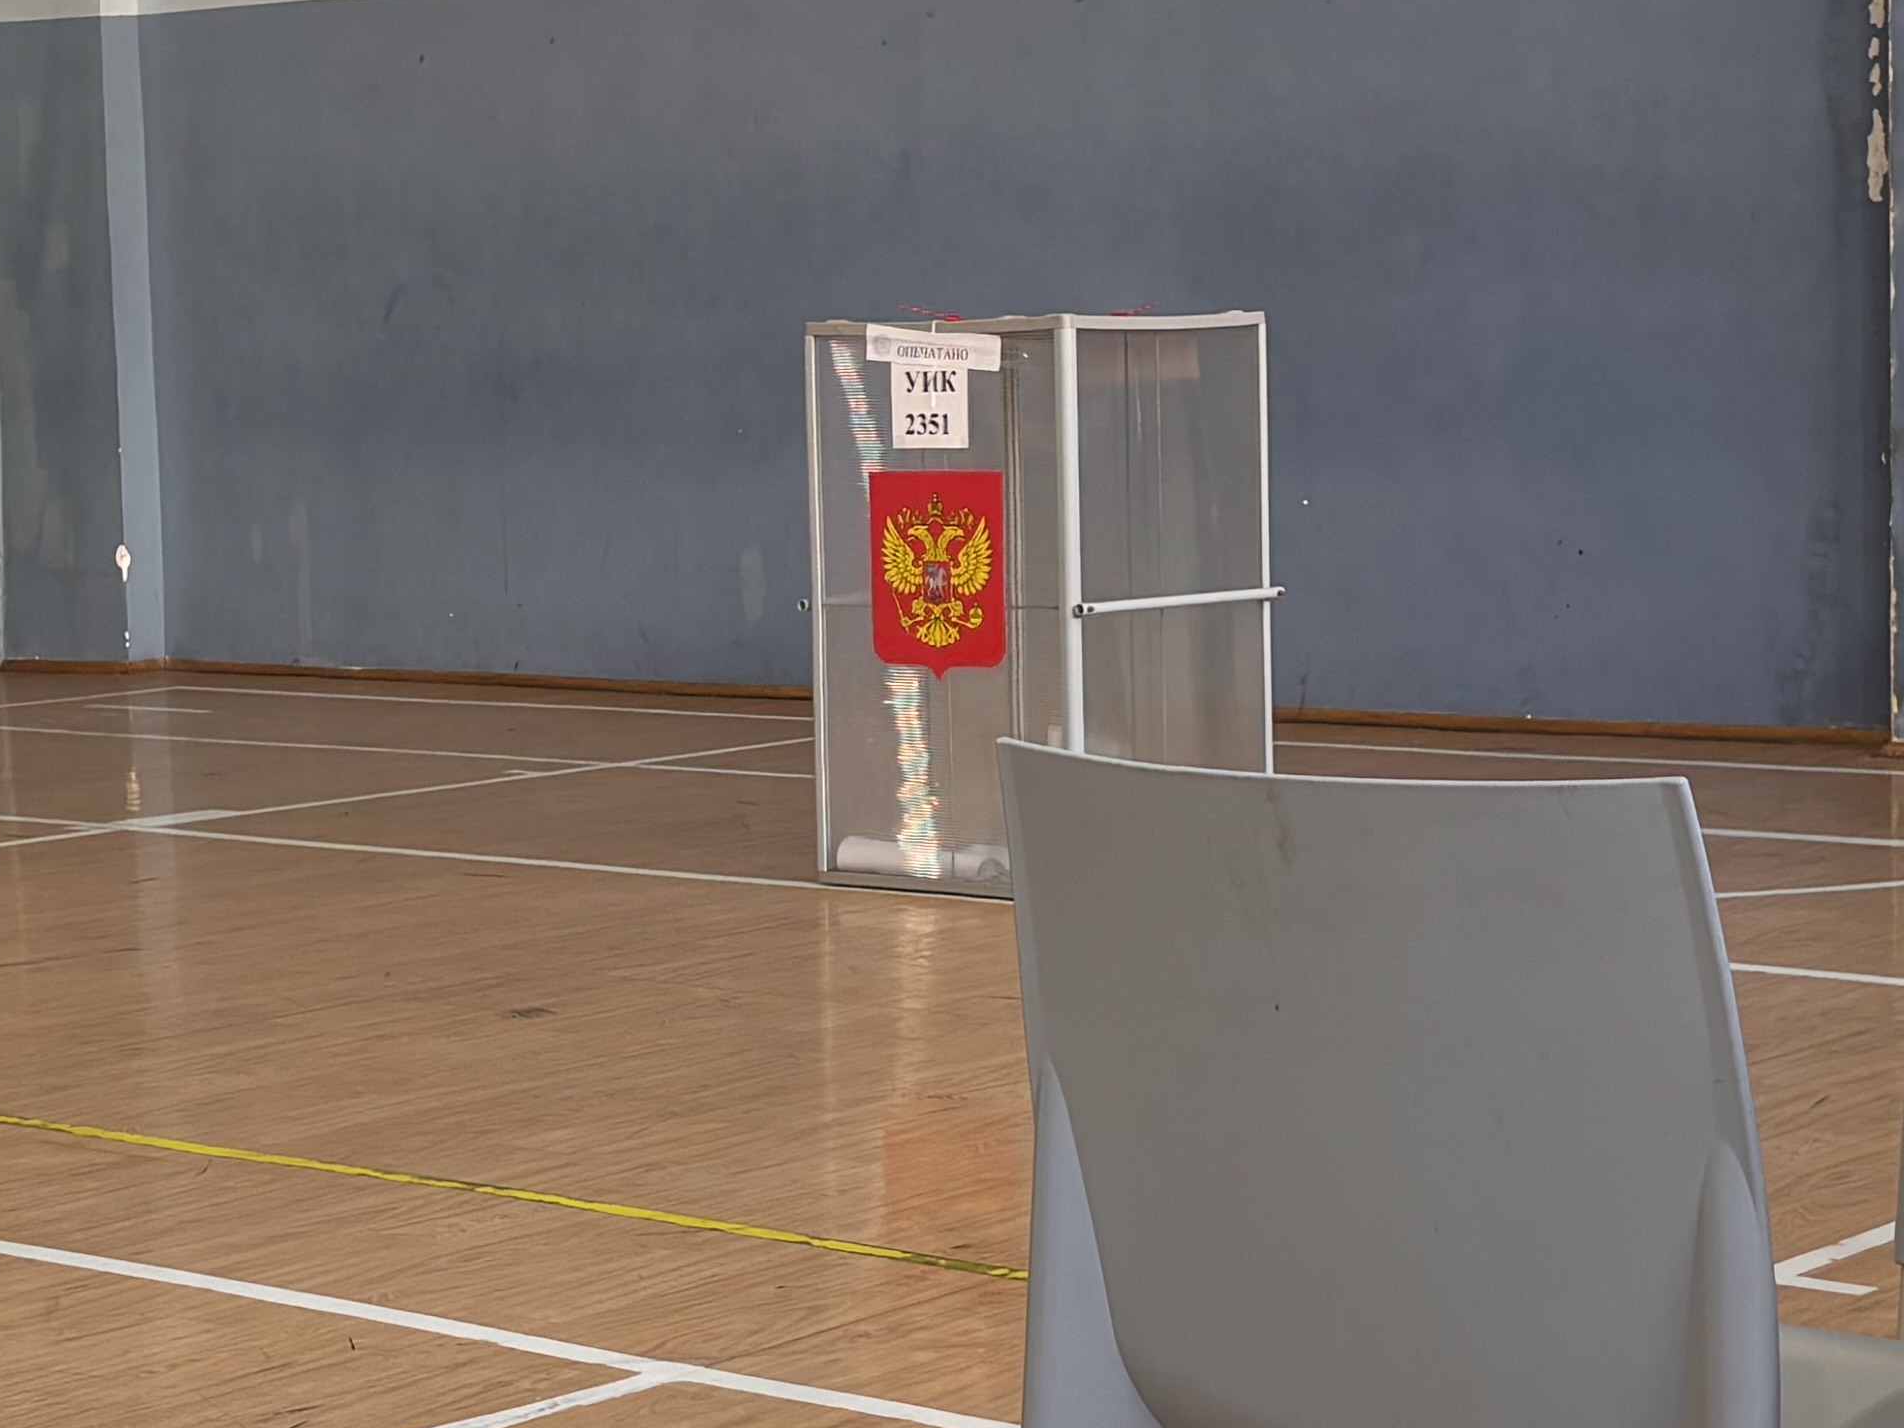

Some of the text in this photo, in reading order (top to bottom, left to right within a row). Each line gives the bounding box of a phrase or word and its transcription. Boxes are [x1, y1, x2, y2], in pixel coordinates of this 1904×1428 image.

[896, 344, 970, 362] ОПЕЧАТАНО
[905, 370, 957, 393] УИК
[904, 413, 950, 436] 2351
